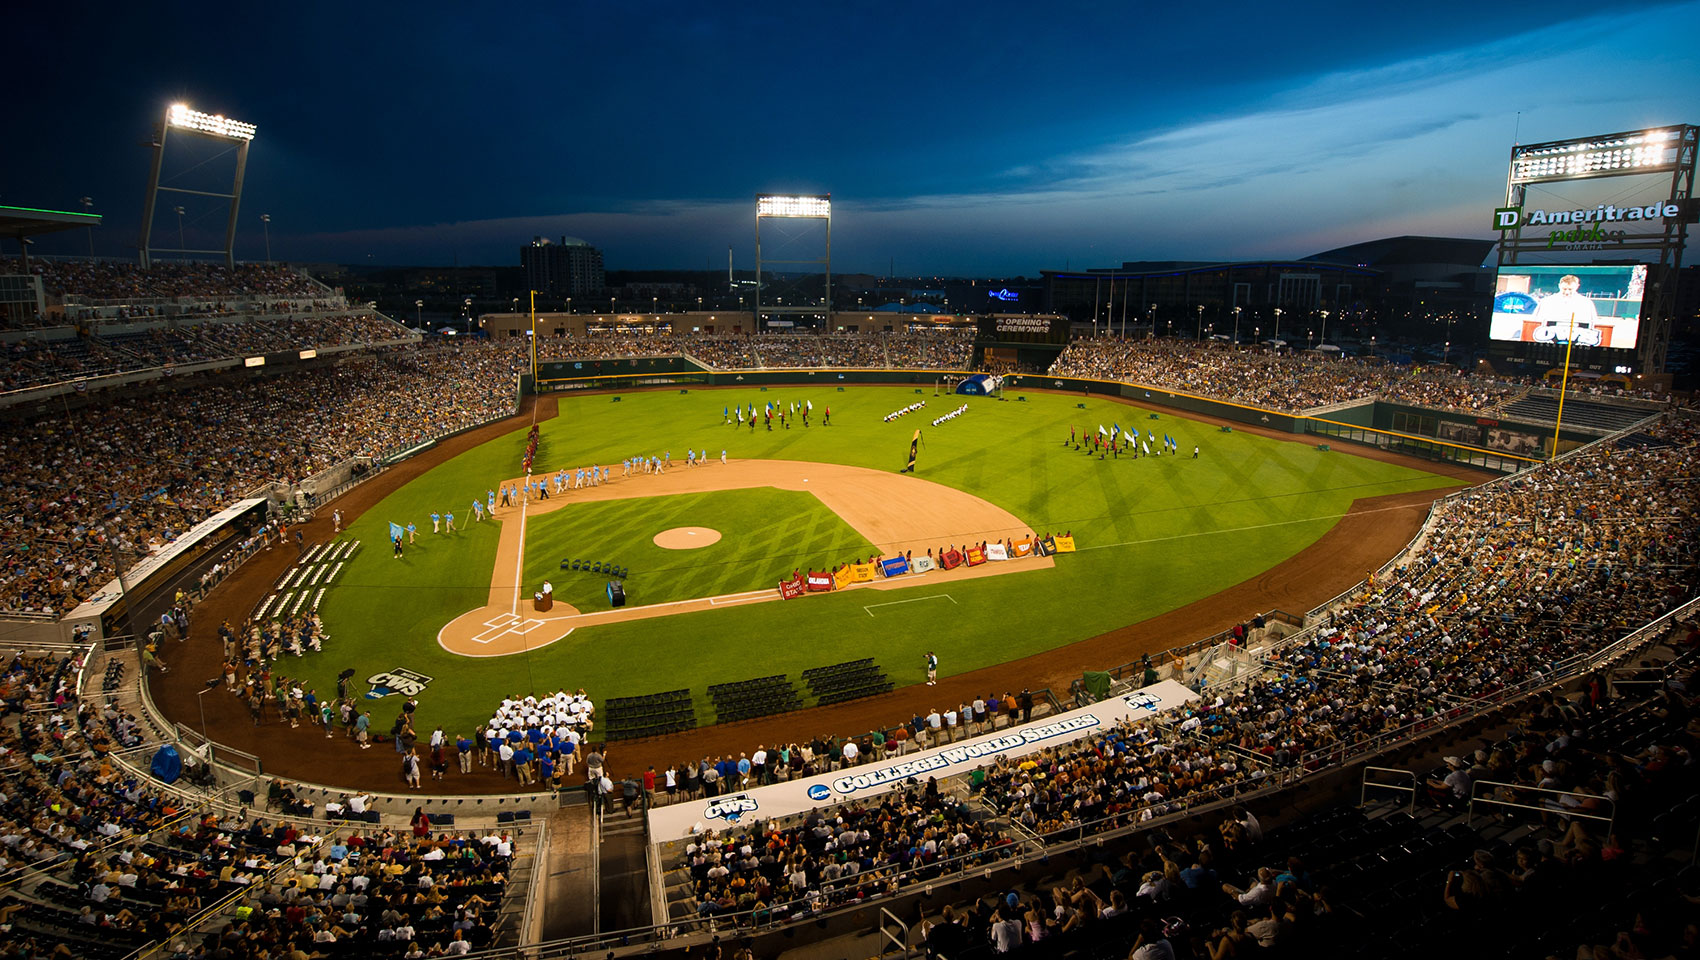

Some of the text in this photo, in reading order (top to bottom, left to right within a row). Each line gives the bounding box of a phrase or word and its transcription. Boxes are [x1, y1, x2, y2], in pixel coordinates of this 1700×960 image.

[1497, 201, 1679, 226] TD Ameritrade
[1547, 221, 1606, 249] park
[1005, 318, 1042, 326] OPENING
[785, 585, 803, 597] STATE
[367, 672, 427, 696] CWS
[811, 714, 1101, 799] NCAA COLLEGE WORLD SERIES
[704, 798, 759, 819] CWS
